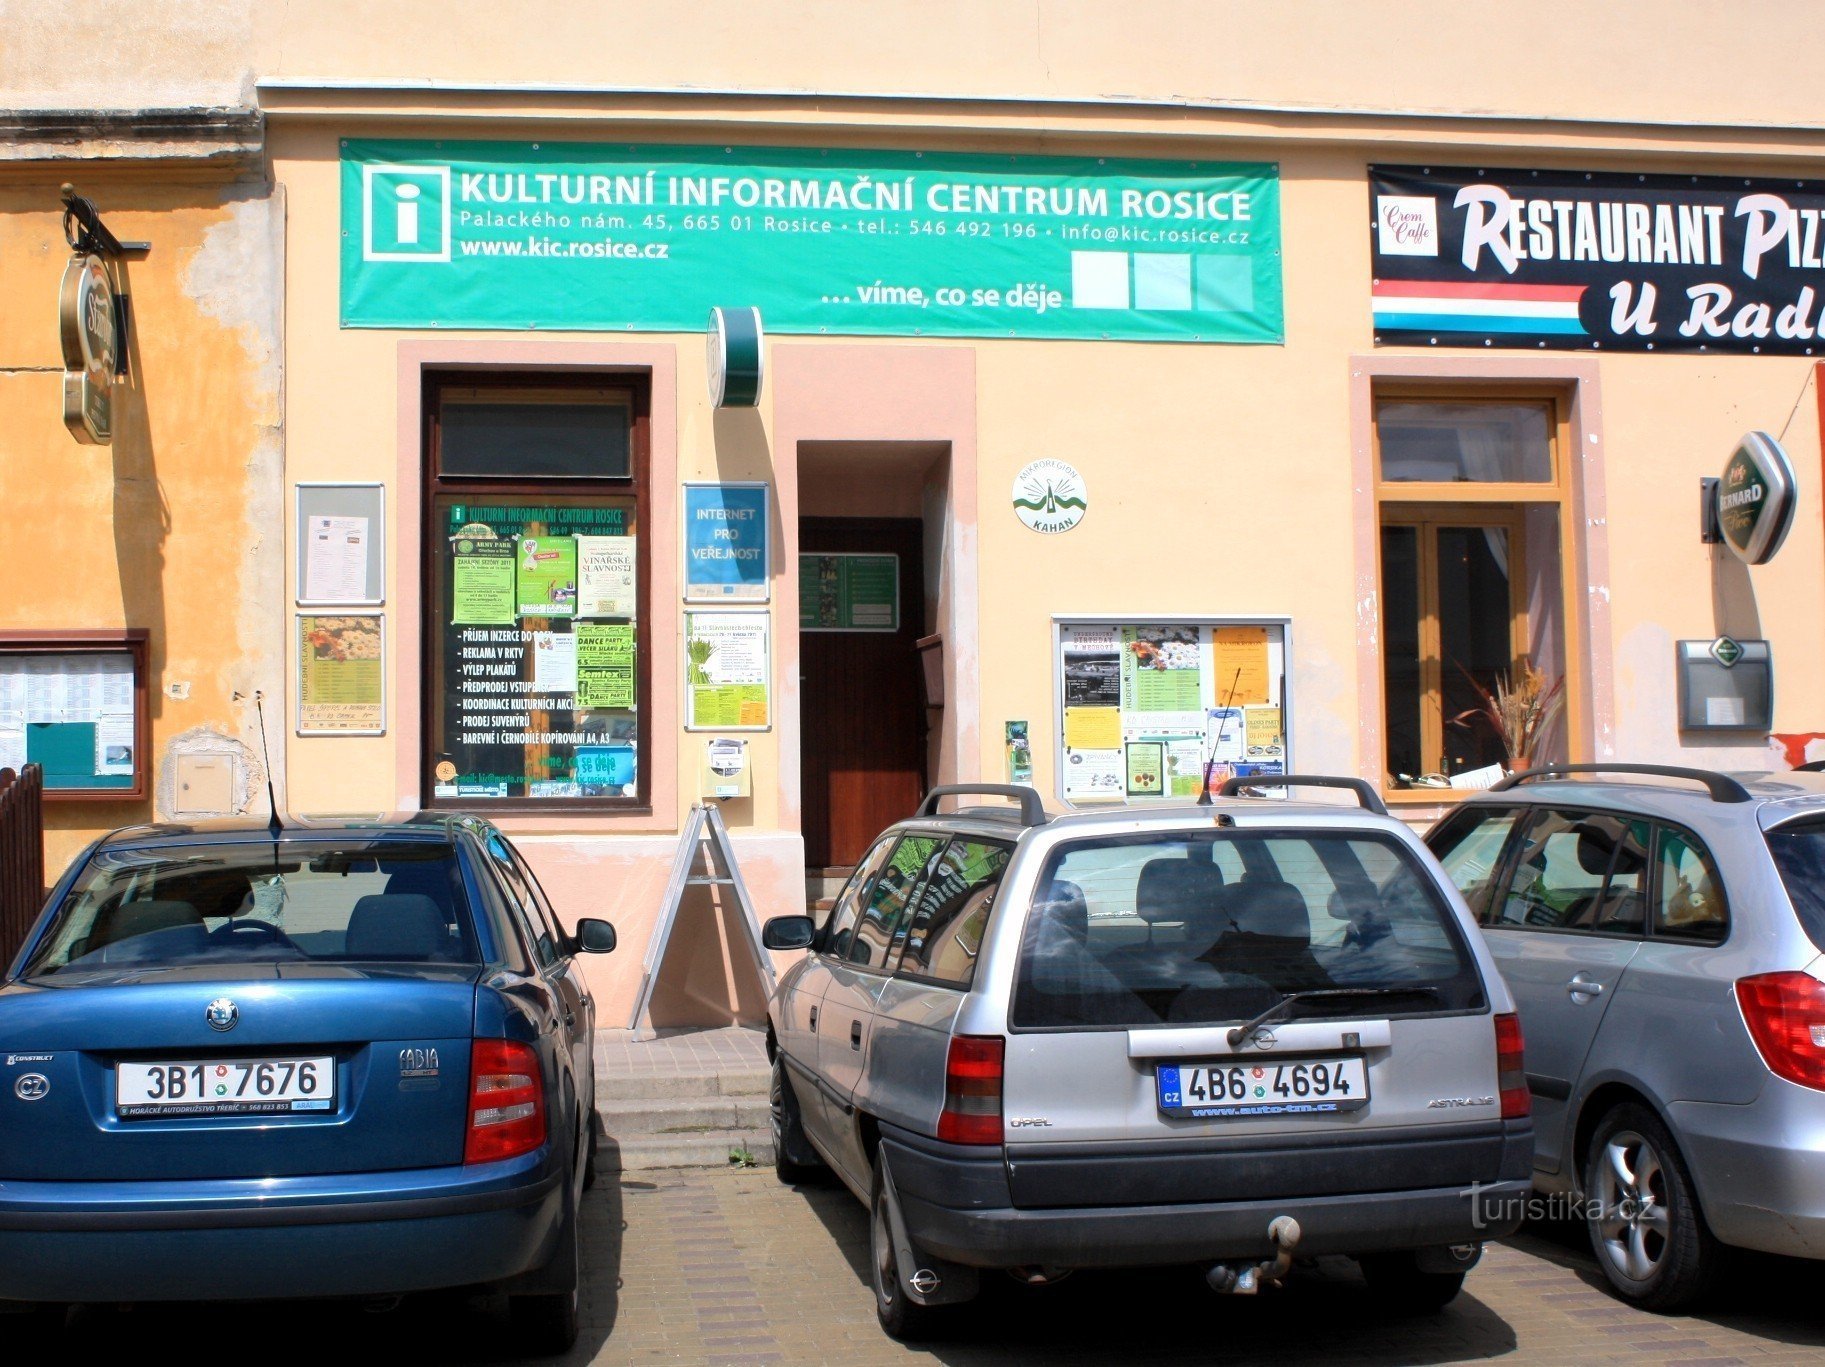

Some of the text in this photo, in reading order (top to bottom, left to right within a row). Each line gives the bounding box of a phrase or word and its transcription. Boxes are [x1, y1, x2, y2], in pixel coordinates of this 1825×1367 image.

[461, 171, 1252, 221] KULTURNÍ INFORMAČNÍ CENTRUM ROSICE
[461, 210, 1249, 245] Palackého nám. 45, 665 01 Rosice tel.: 546 492 196 info@kic.rosice.cz
[1453, 184, 1724, 275] RESTAURANT
[461, 236, 669, 259] www.kic.rosice.cz
[857, 281, 929, 309] víme,
[936, 285, 966, 306] co
[972, 286, 999, 307] se
[1005, 284, 1062, 315] děje
[1609, 280, 1658, 335] U
[1020, 460, 1077, 481] MIKROREGION
[559, 509, 593, 523] CENTRUM
[595, 509, 622, 523] ROSICE
[696, 509, 756, 520] INTERNET
[1033, 518, 1074, 533] KAHAN
[714, 528, 739, 540] PRO
[692, 545, 761, 560] VEŘEJNOST
[463, 628, 489, 642] PŘÍJEM
[490, 630, 520, 642] INZERCE
[521, 630, 532, 642] DO
[463, 648, 524, 659] REKLAMA V RKTV
[463, 661, 517, 676] VÝLEP PLAKÁTŮ
[578, 670, 619, 678] Semtex
[463, 679, 509, 693] PŘEDPRODEJ
[463, 696, 574, 710] KOORDINACE KULTURNÍCH AKCÍ
[463, 712, 530, 727] PRODEJ SUVENÝRŮ
[463, 731, 496, 744] BAREVNÉ
[501, 730, 540, 744] ČERNOBÍLÉ
[541, 730, 586, 744] KOPÍROVÁNÍ
[586, 733, 599, 746] A4,
[600, 733, 610, 744] A3
[400, 1048, 439, 1070] FABIA
[20, 1079, 43, 1095] CZ
[146, 1061, 318, 1100] 3B1 7676
[1188, 1063, 1350, 1101] 4B6 4694
[1165, 1092, 1180, 1103] CZ
[1427, 1097, 1474, 1109] ASTRA
[129, 1105, 161, 1115] HORÁCKÉ
[163, 1104, 215, 1114] AUTODRUŽSTVO
[217, 1103, 240, 1112] TŘEBÍČ
[1191, 1103, 1337, 1117] www.auto-tm.cz
[1010, 1117, 1053, 1128] OPEL
